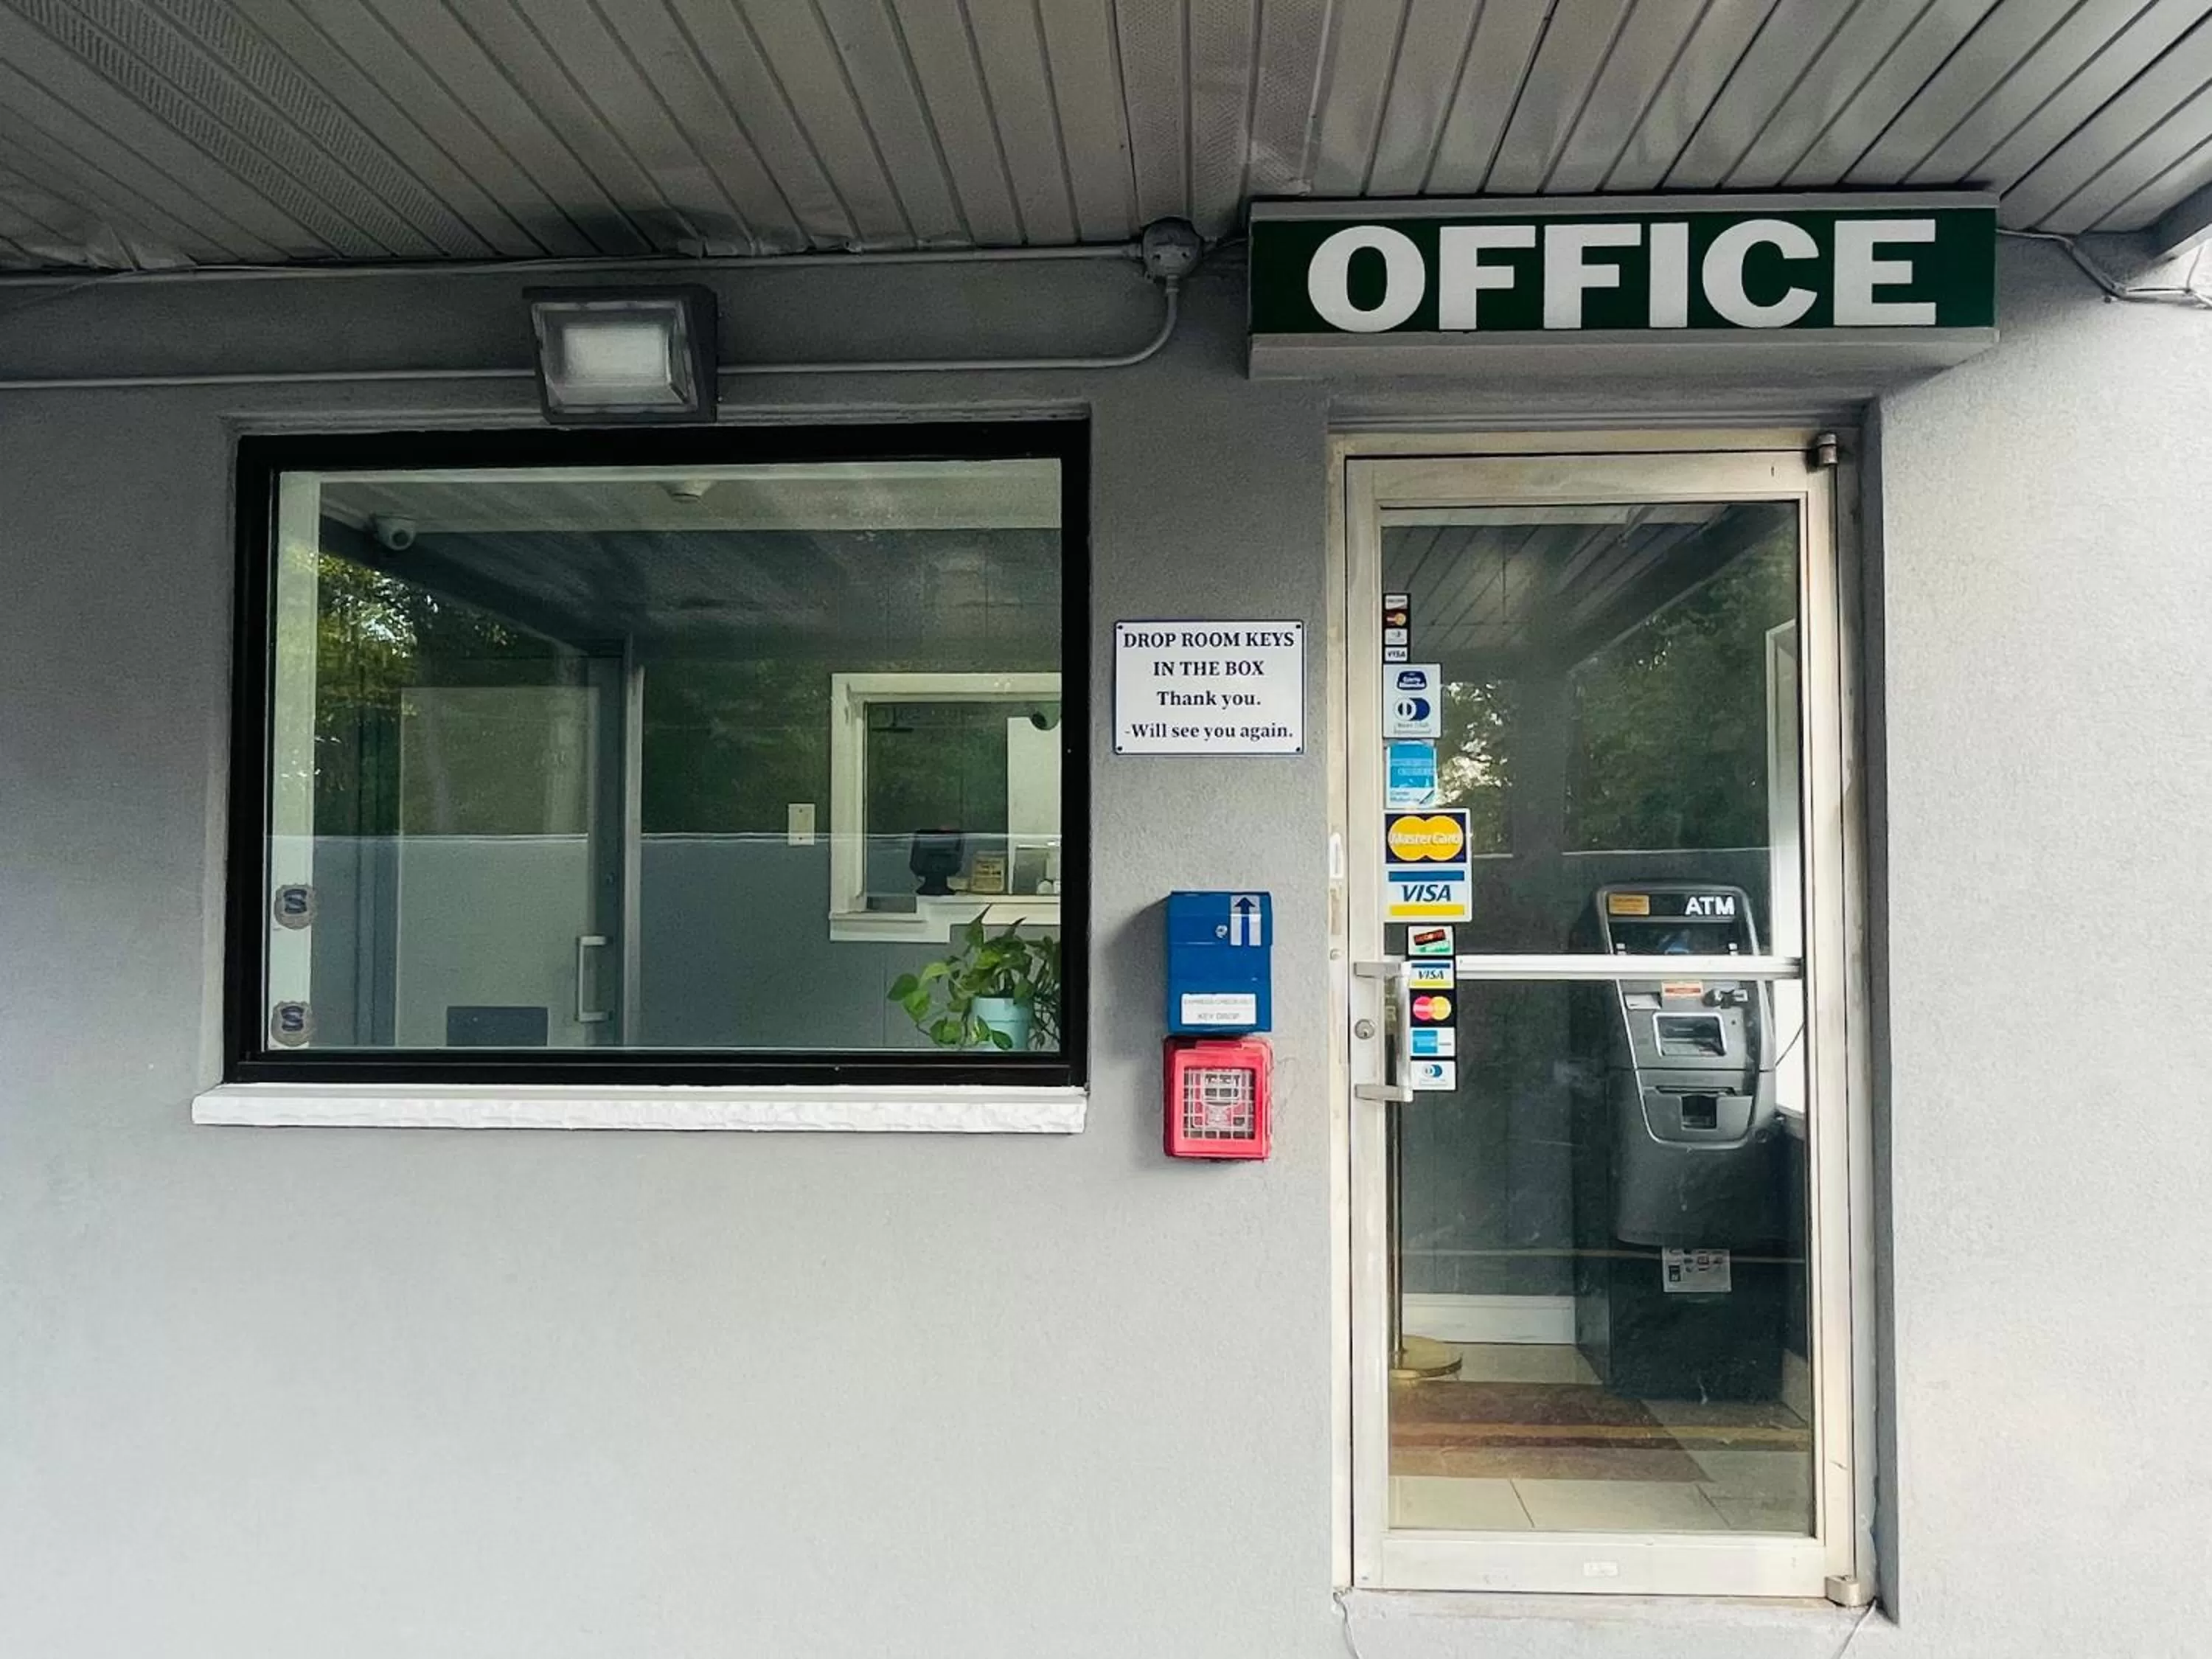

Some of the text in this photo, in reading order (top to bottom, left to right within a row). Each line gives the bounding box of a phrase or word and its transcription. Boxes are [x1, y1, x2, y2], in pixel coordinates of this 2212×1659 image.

[1307, 219, 1936, 332] OFFICE
[1123, 632, 1294, 648] DROP ROOM KEYS
[1388, 650, 1405, 658] VISA
[1153, 661, 1265, 676] IN THE BOX
[1157, 690, 1262, 709] Thank you.
[1172, 727, 1200, 738] see
[1203, 727, 1236, 742] you
[1239, 723, 1293, 742] again.
[1402, 885, 1451, 902] VISA
[1685, 896, 1735, 915] ATM
[1418, 970, 1444, 979] VISA
